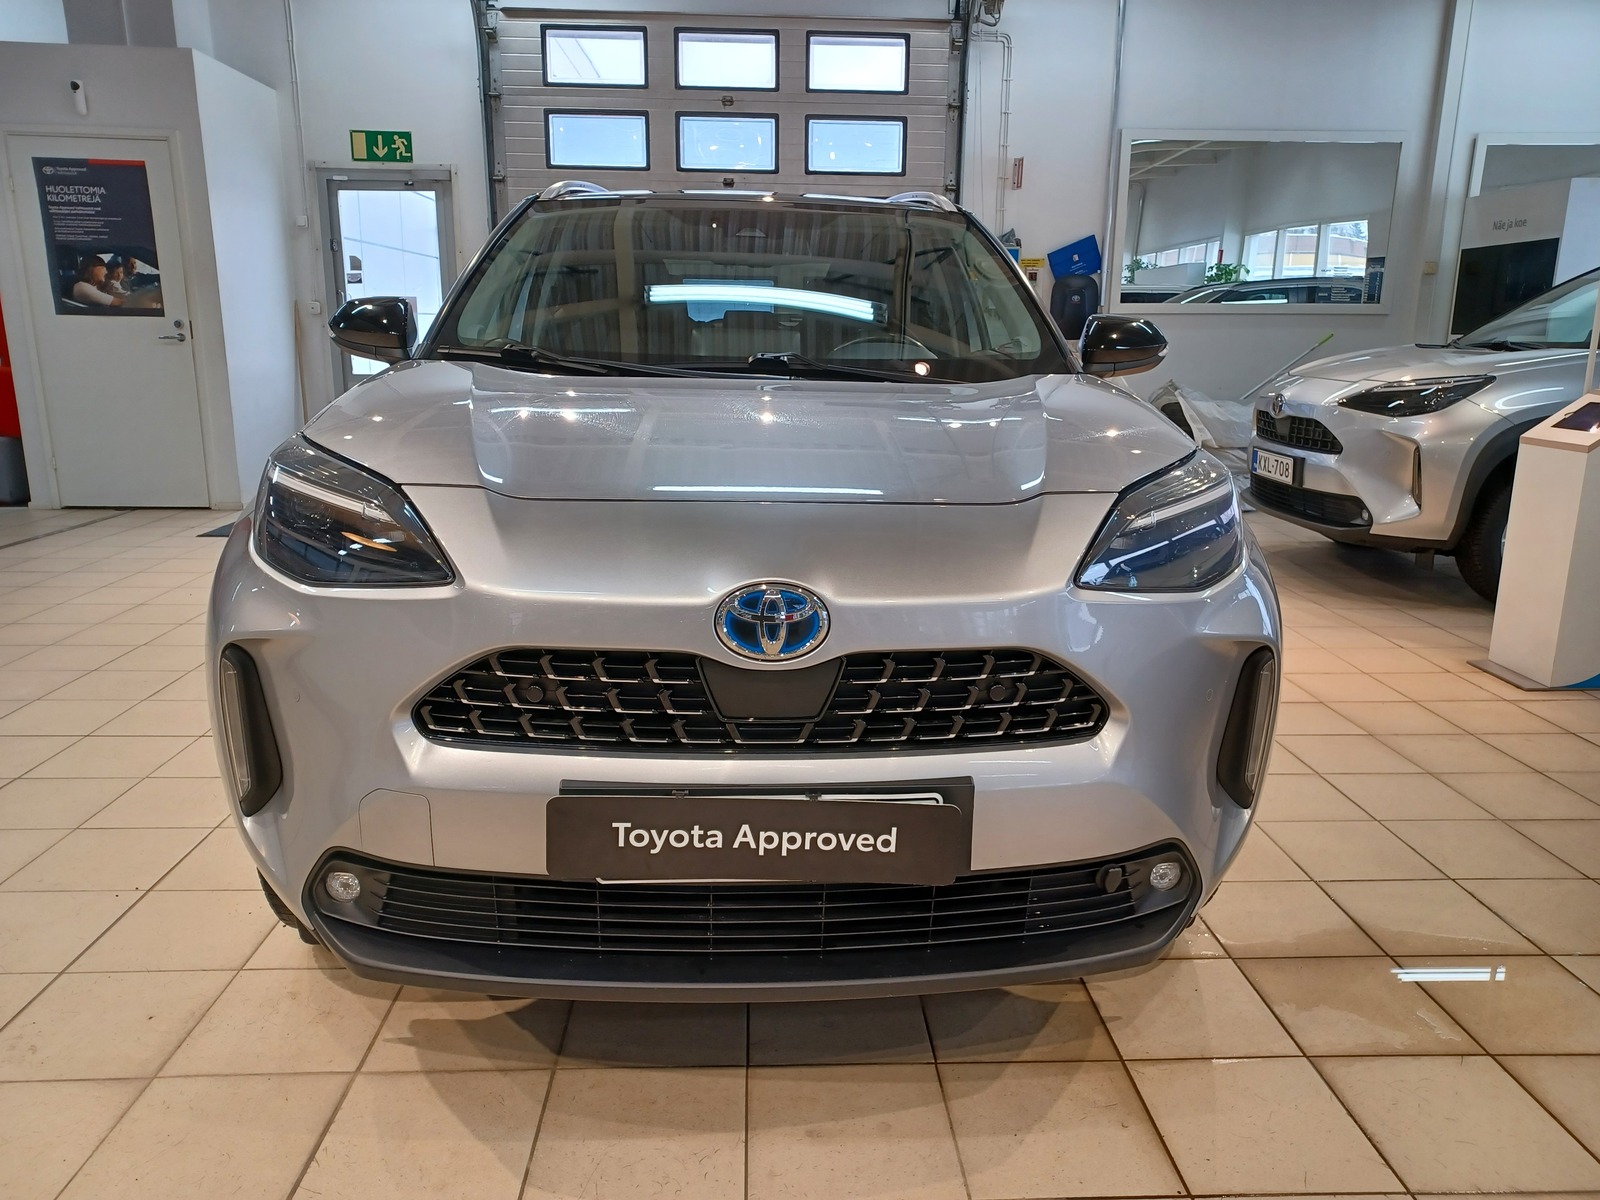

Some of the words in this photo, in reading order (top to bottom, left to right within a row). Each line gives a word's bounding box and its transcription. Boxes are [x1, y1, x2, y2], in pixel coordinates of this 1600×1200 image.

[45, 185, 106, 195] HUOLETTOMIA
[46, 193, 102, 203] KILOMETREJÄ
[1493, 220, 1506, 231] Näe
[1506, 219, 1514, 231] ja
[1514, 218, 1527, 228] koe
[1257, 454, 1290, 478] KXL-708
[611, 822, 723, 854] Toyota
[732, 823, 898, 856] Approved
